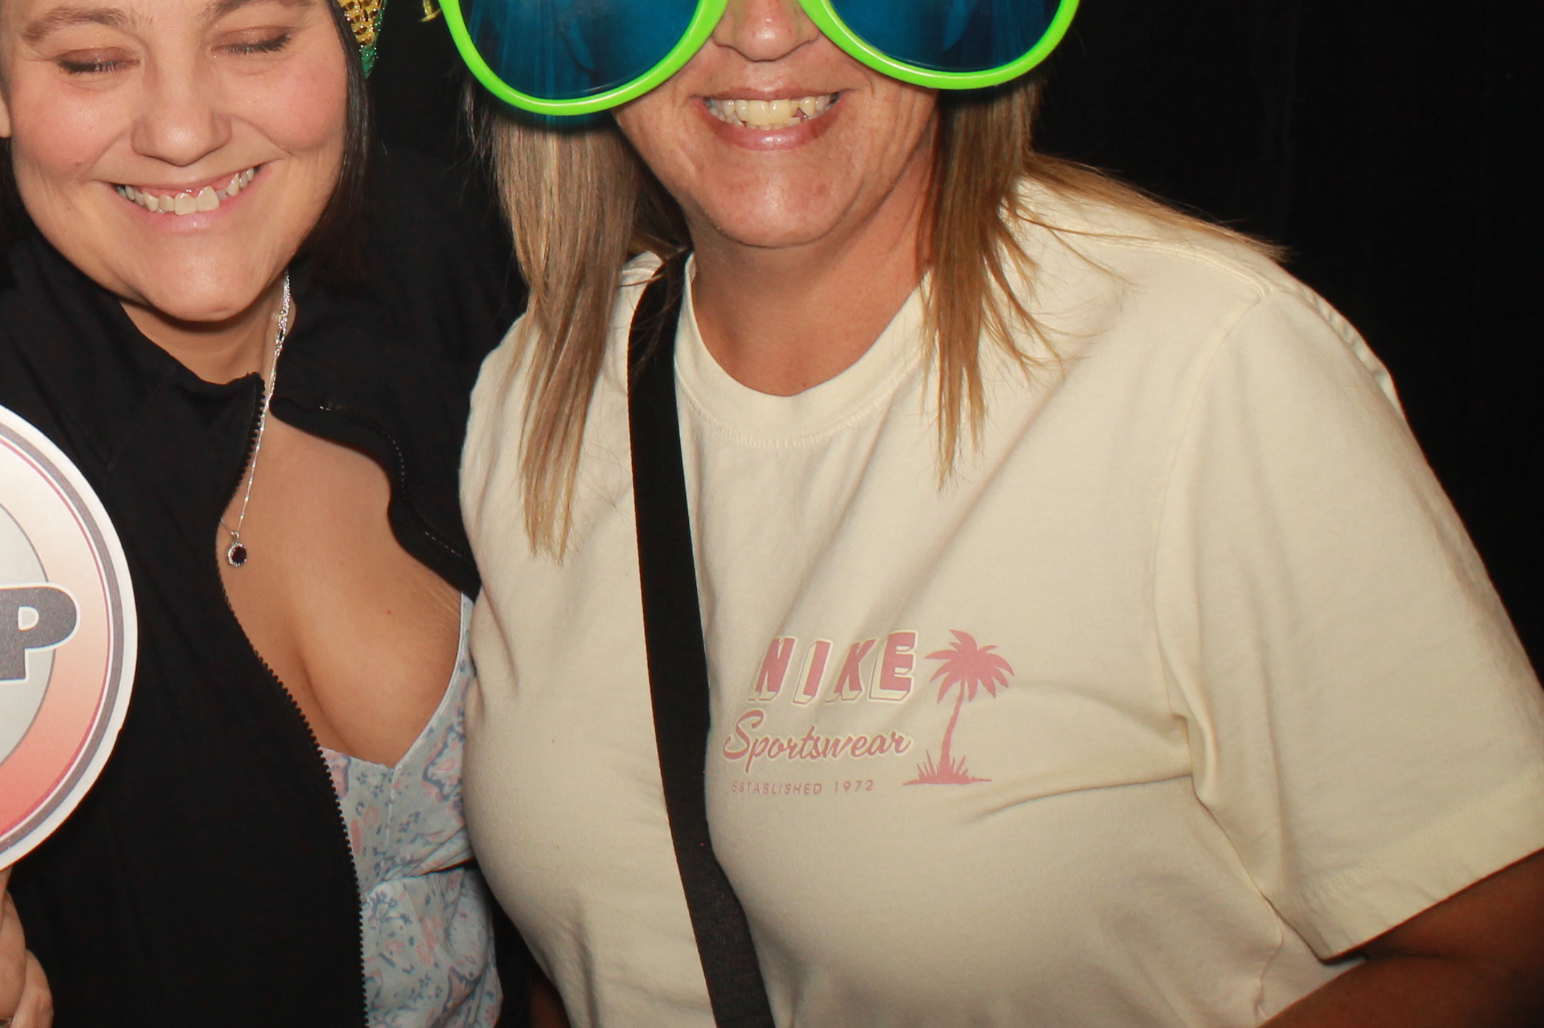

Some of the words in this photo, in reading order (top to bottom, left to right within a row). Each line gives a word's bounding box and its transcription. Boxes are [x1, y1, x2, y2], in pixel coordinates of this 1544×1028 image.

[749, 631, 917, 704] NIKE
[722, 710, 911, 773] Sportswear
[732, 780, 823, 795] ESTABLISHED
[834, 779, 874, 793] 1972
